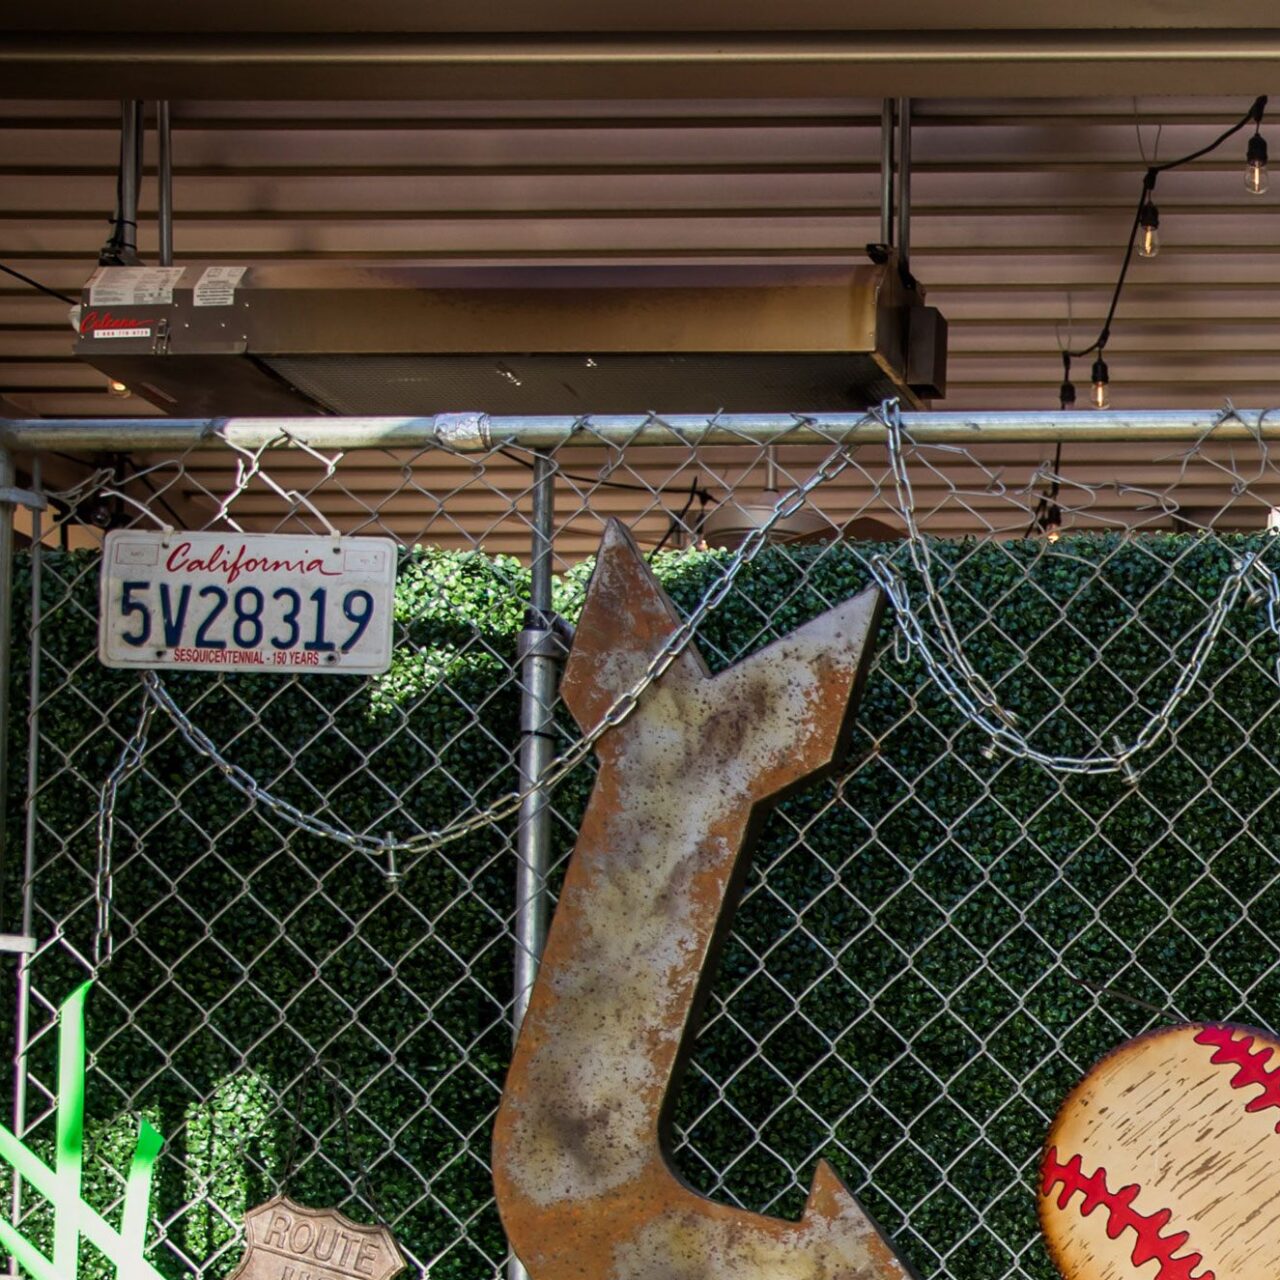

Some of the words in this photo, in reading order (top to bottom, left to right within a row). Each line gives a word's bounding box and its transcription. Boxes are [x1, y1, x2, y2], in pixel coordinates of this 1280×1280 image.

[166, 542, 342, 585] California
[122, 580, 374, 655] 5V28319
[174, 649, 264, 665] SESQUICENTENNIAL
[272, 651, 287, 665] 150
[287, 652, 319, 666] YEARS
[263, 1210, 380, 1276] ROUTE
